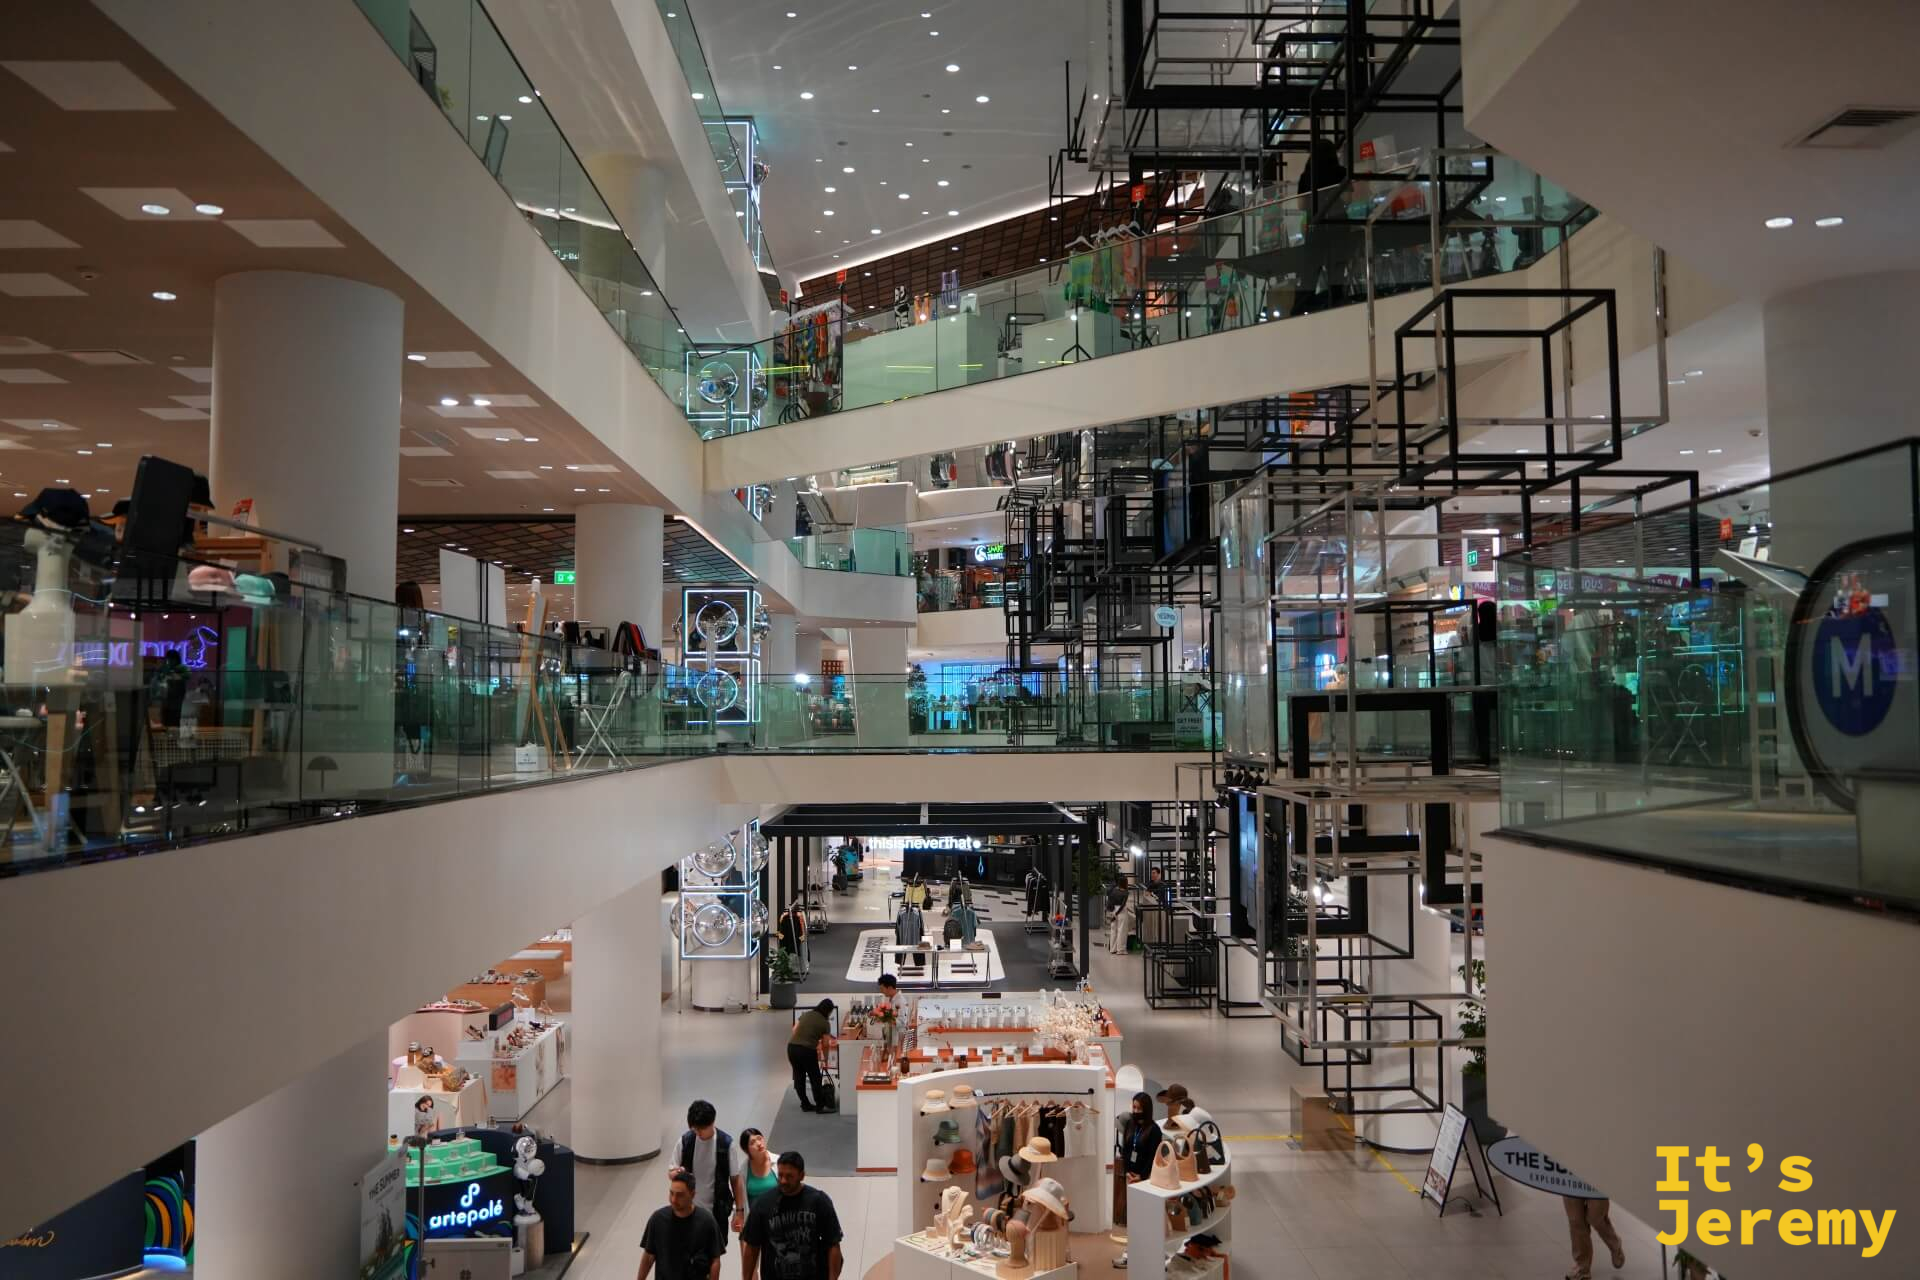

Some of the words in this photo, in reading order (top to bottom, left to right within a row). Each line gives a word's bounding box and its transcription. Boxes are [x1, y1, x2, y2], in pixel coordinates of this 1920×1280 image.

[1830, 633, 1873, 698] M
[1504, 1152, 1540, 1169] THE
[368, 1182, 381, 1200] THE
[380, 1168, 401, 1191] SUMMER
[430, 1200, 503, 1228] artepolé
